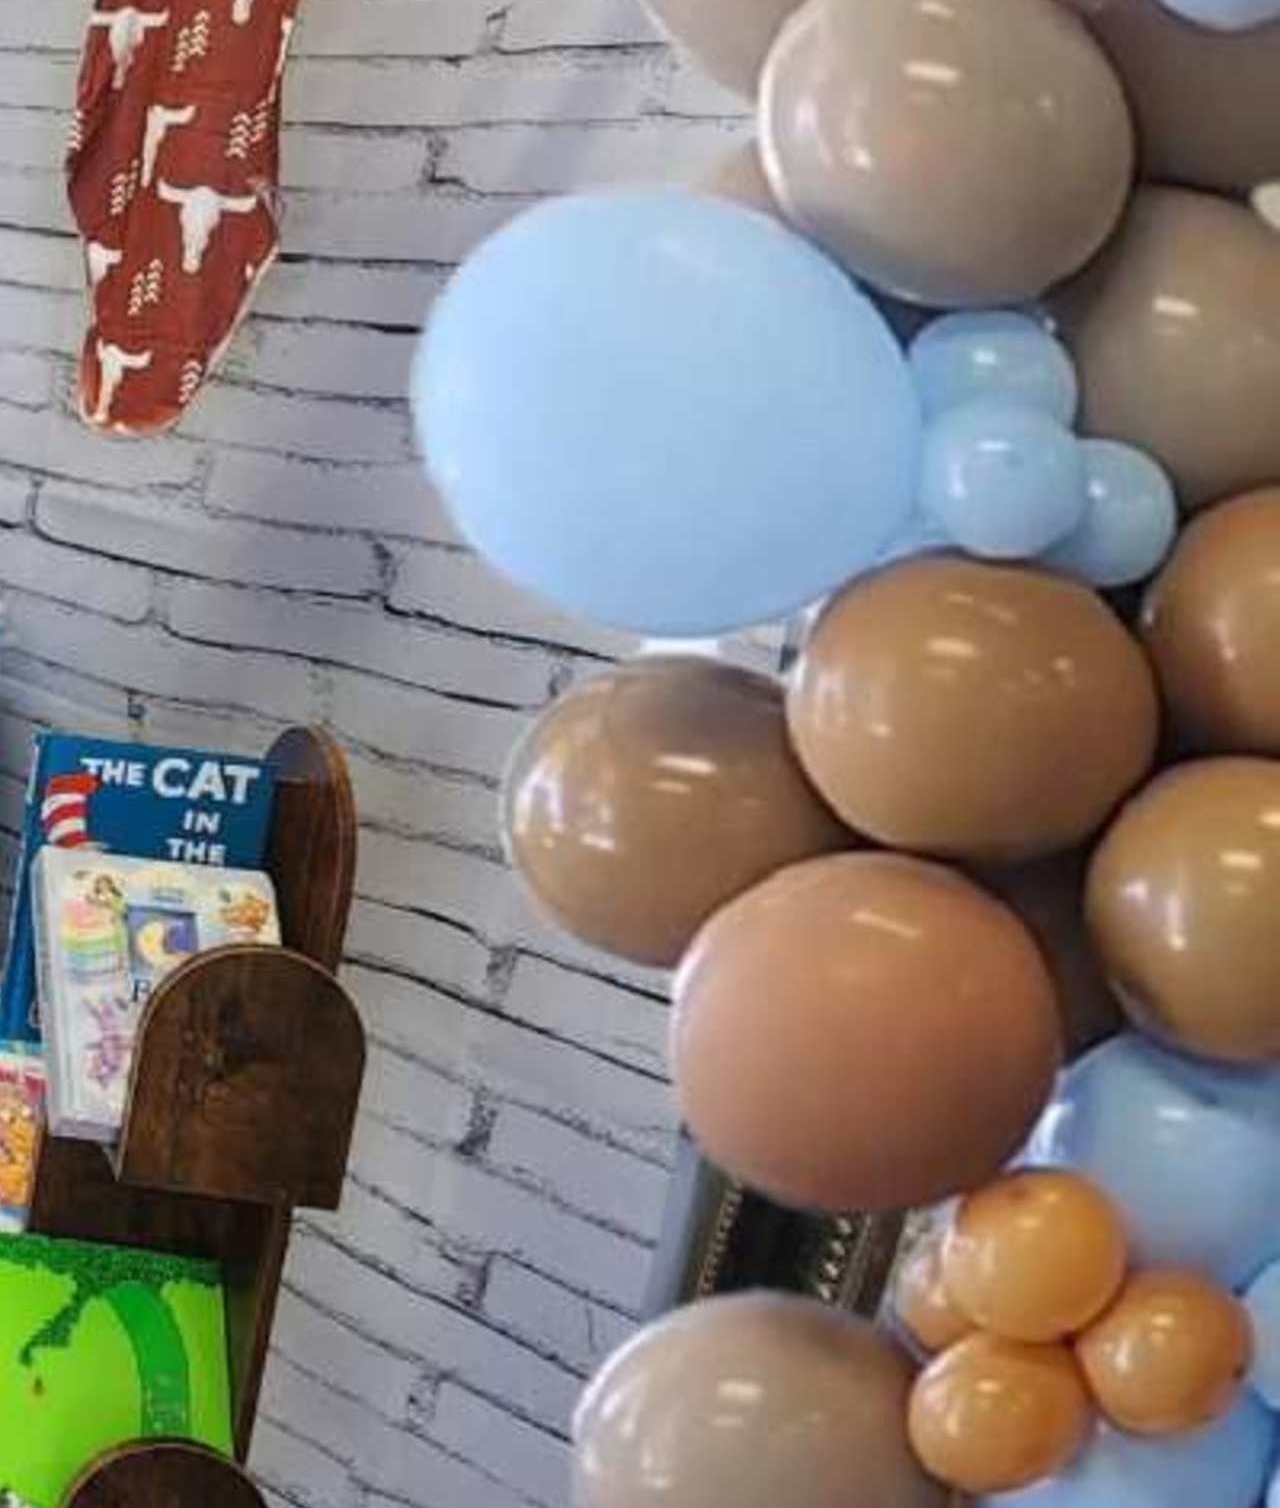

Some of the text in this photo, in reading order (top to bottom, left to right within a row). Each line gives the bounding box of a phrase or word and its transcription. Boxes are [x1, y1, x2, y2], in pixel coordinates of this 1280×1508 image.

[80, 757, 261, 805] THE CAT
[184, 810, 221, 834] IN
[166, 838, 227, 866] THE
